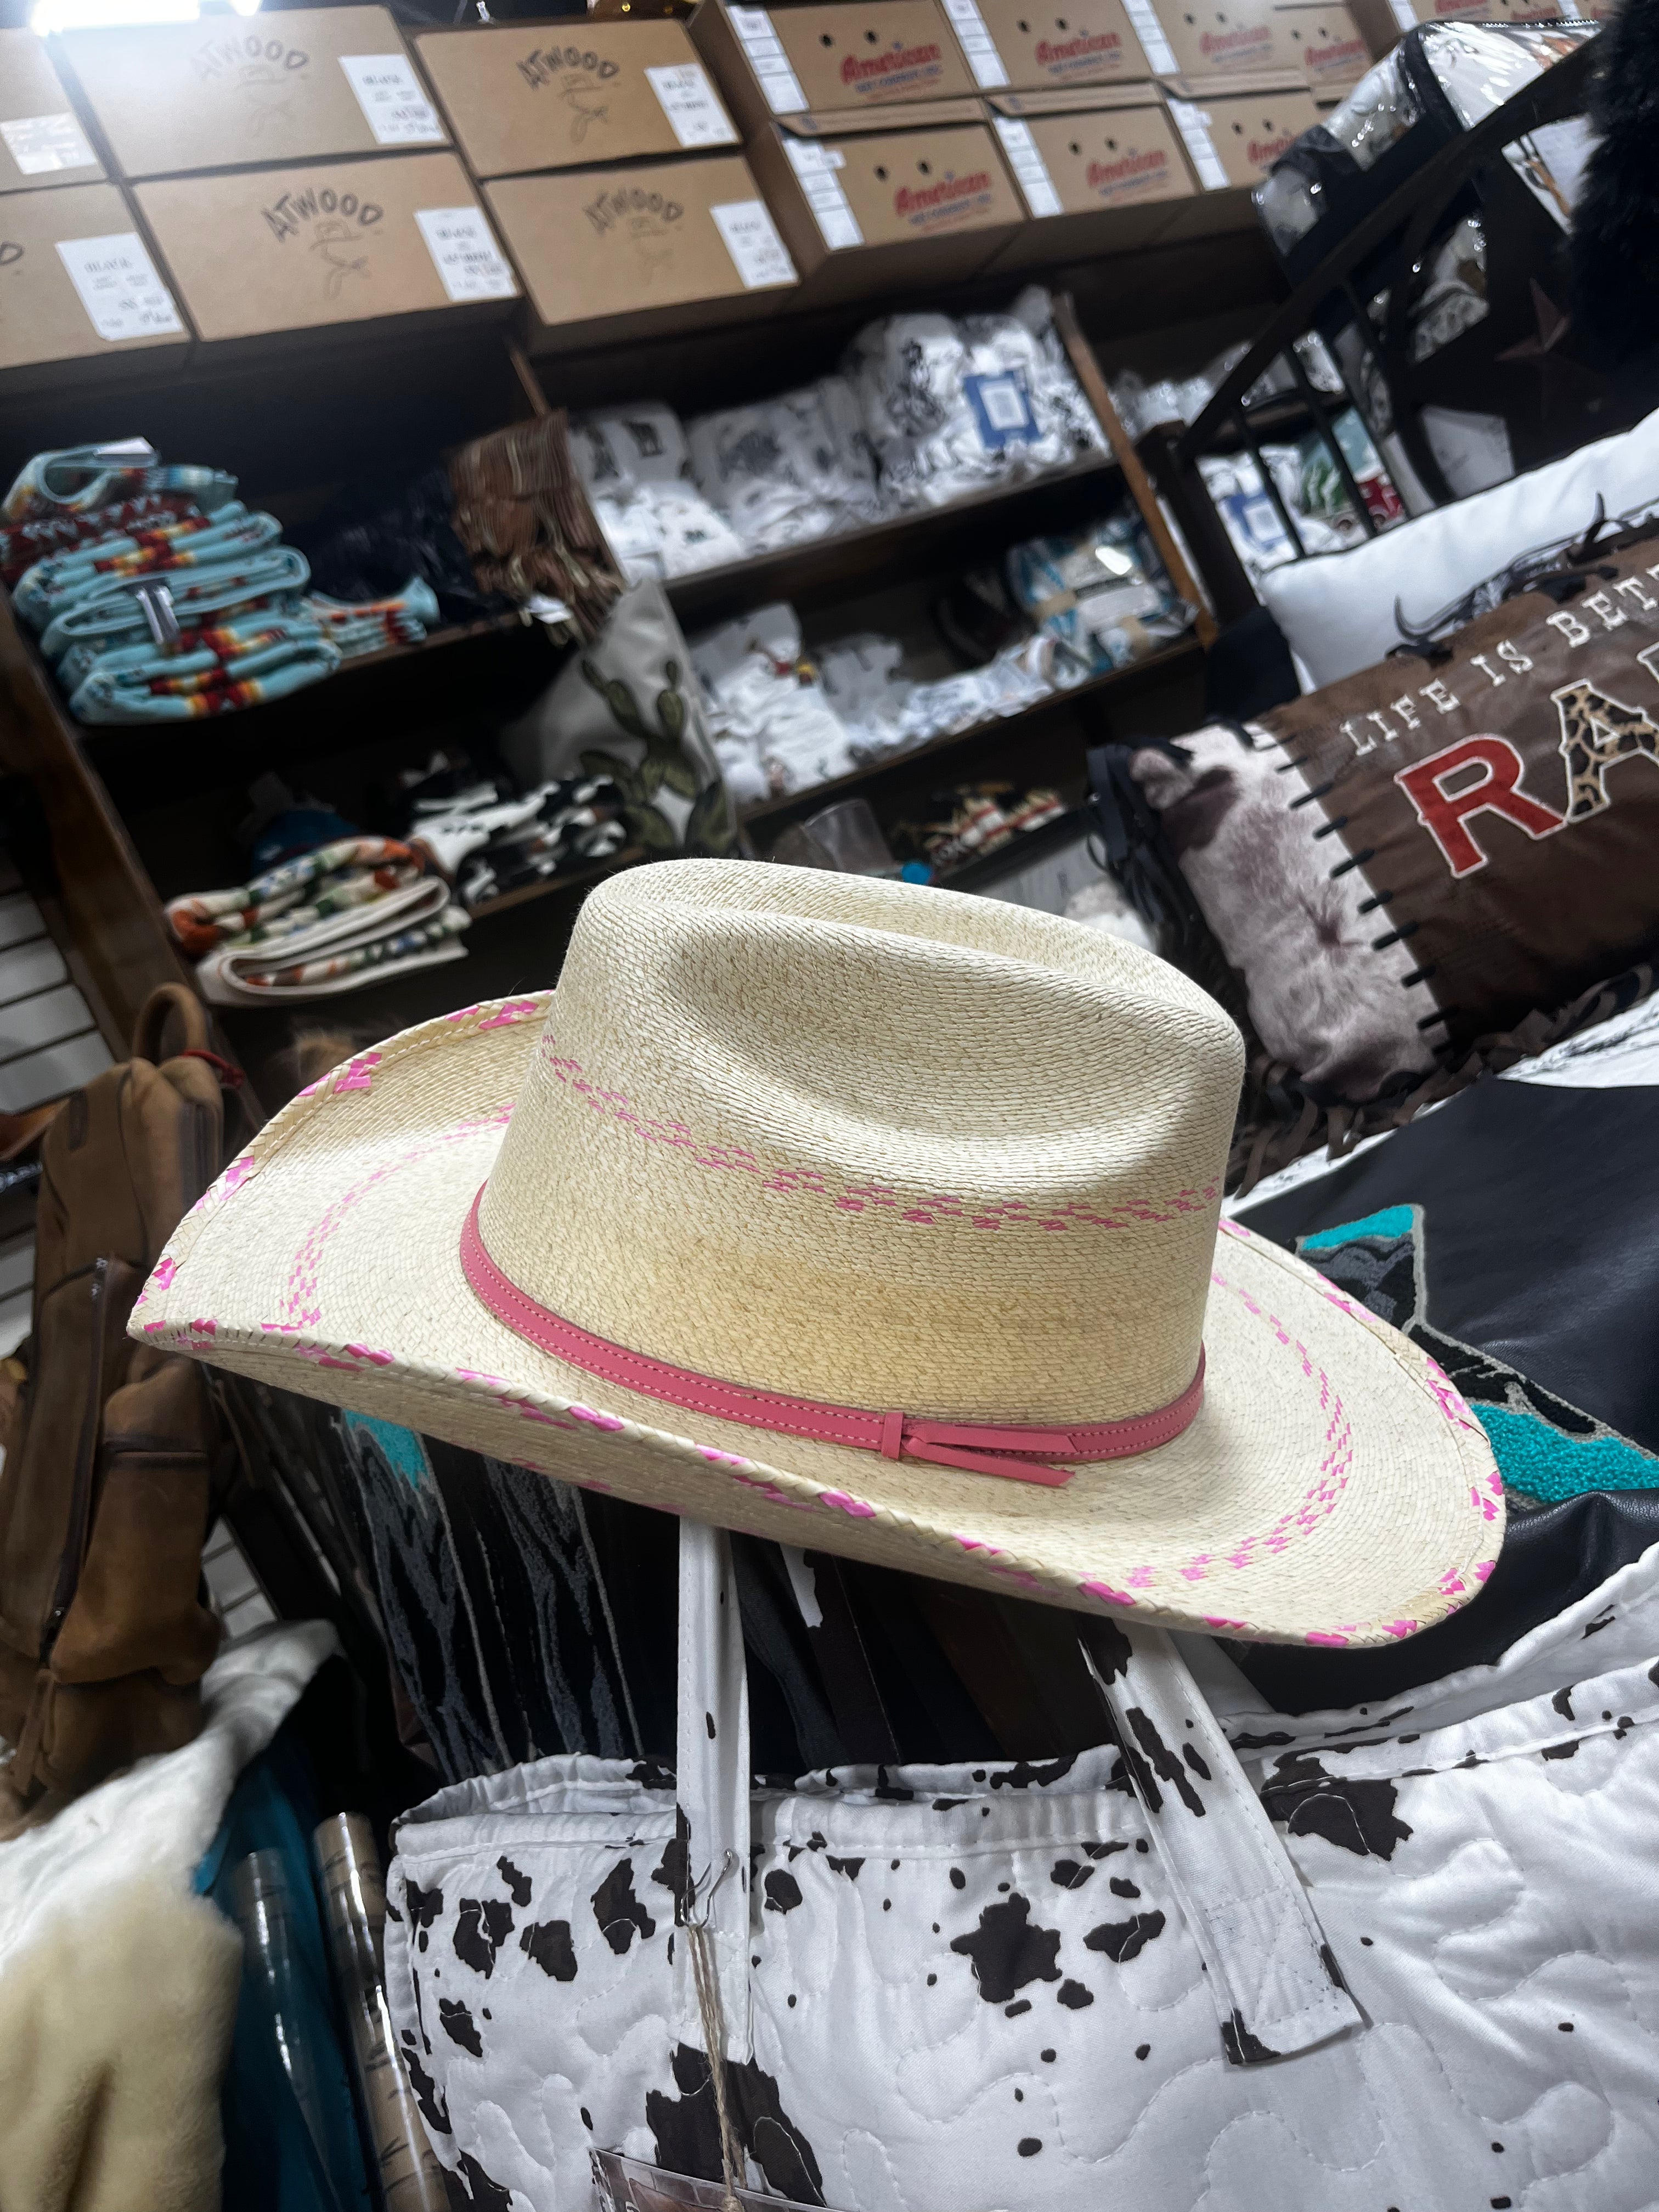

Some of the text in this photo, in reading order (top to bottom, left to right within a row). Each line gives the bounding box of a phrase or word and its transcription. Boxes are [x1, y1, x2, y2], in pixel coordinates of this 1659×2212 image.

[516, 44, 619, 91] ATWOOD
[840, 42, 941, 86] American
[261, 187, 383, 243] ATWOOD
[583, 186, 685, 236] ATWOOD
[1340, 678, 1460, 756] LIFE
[1470, 639, 1534, 687] IS
